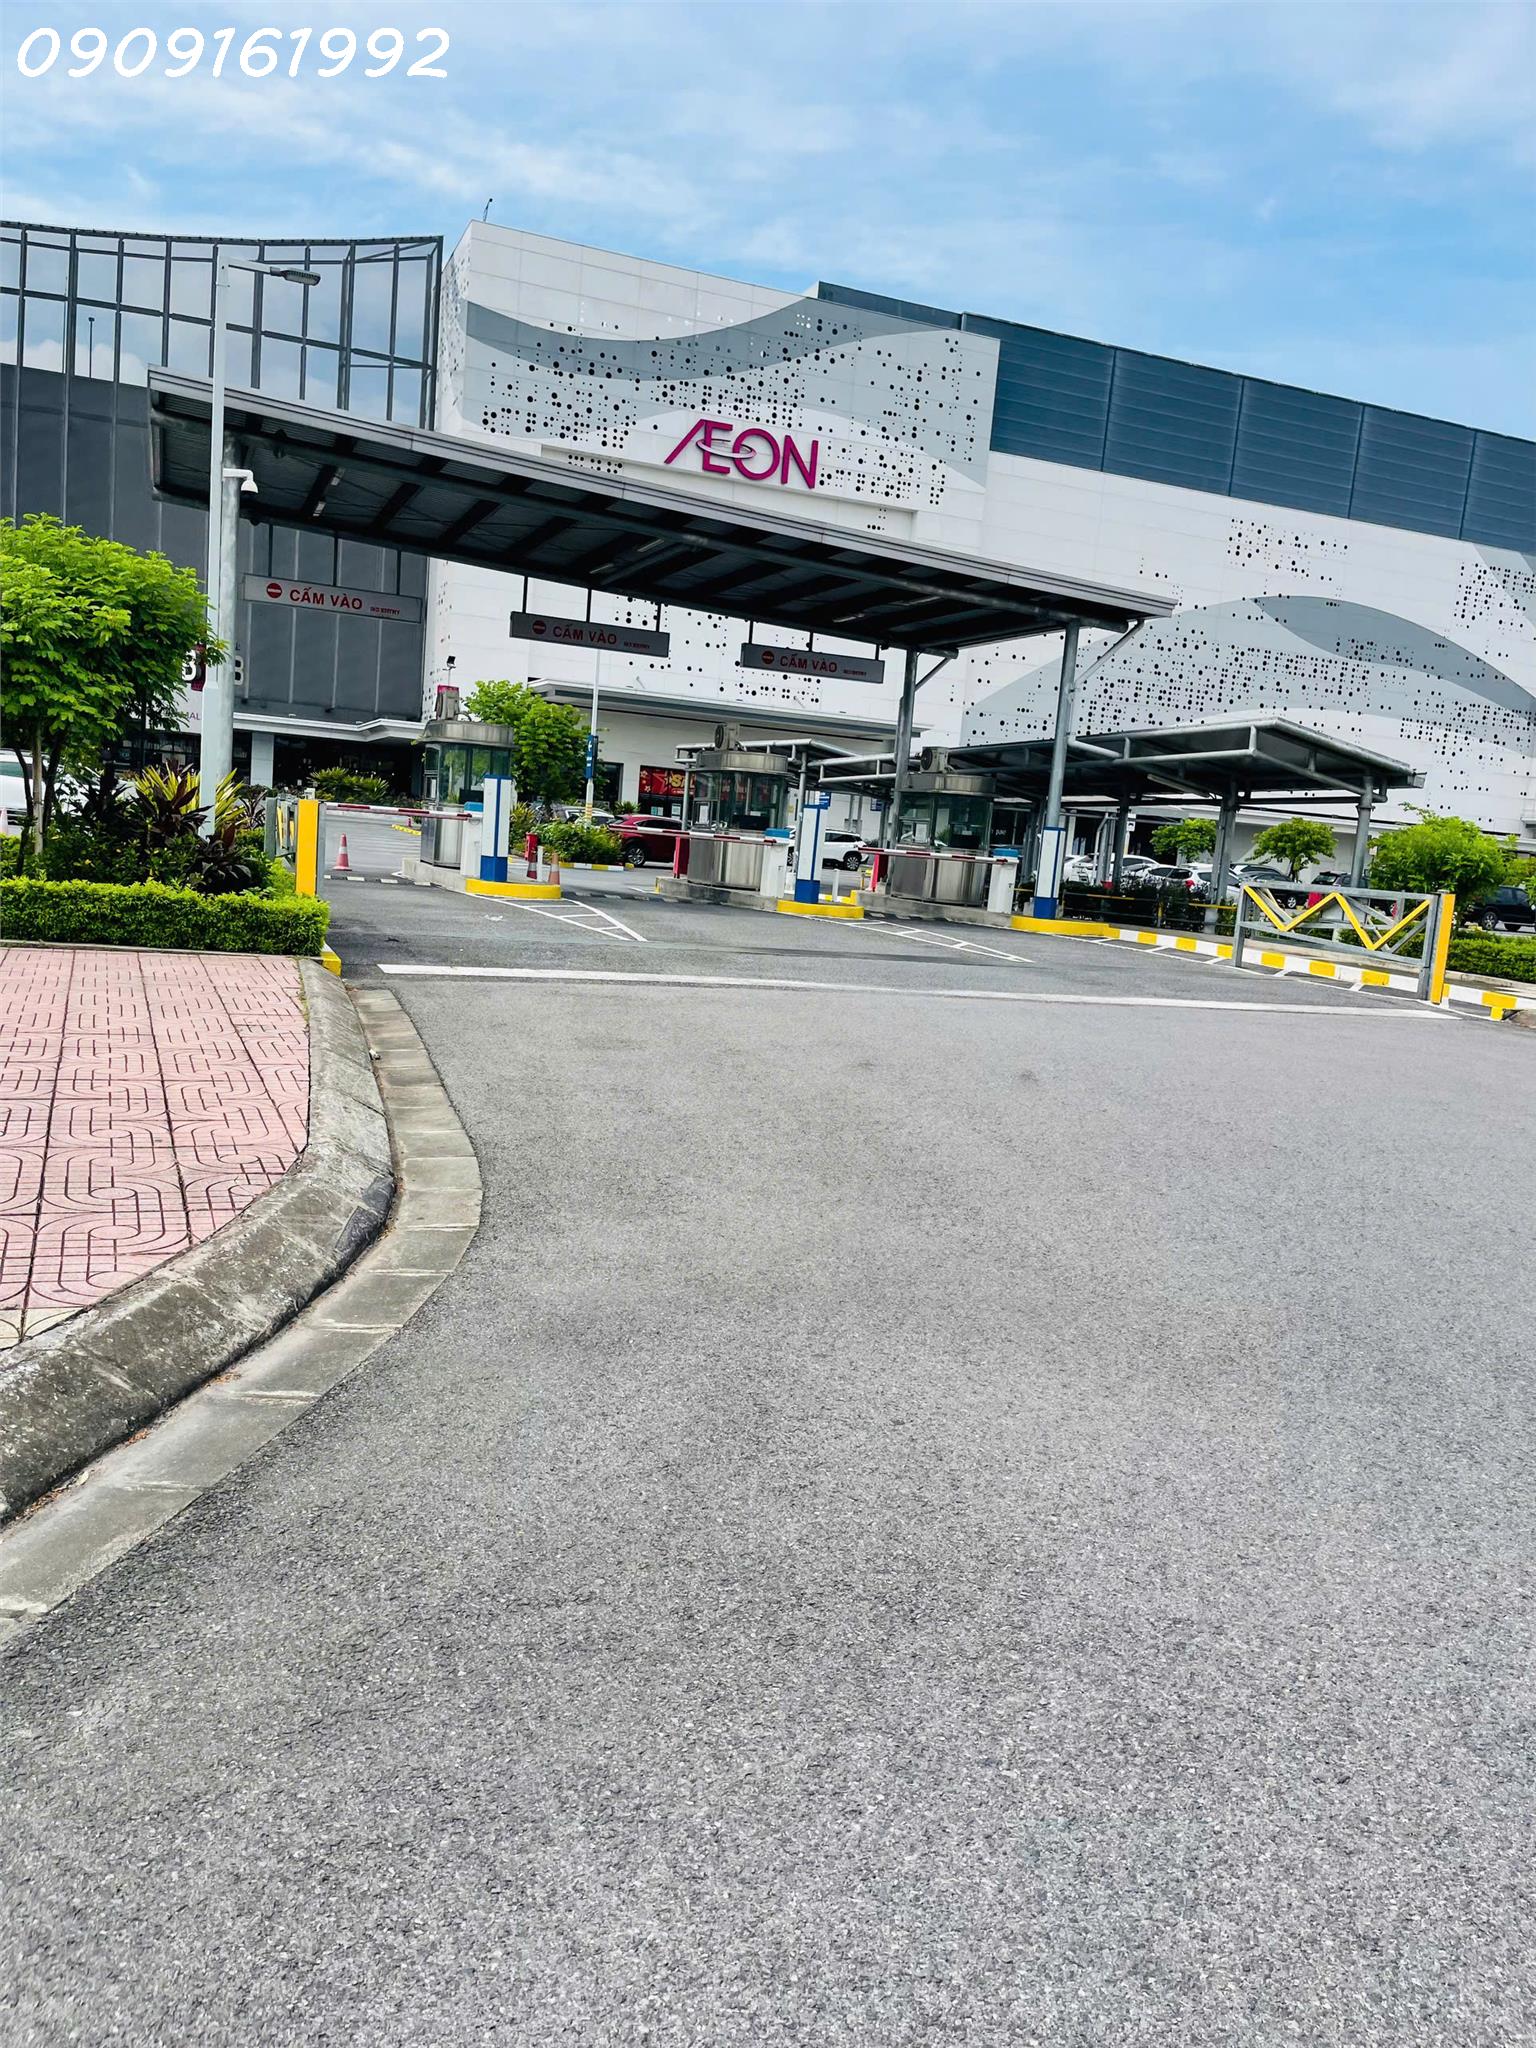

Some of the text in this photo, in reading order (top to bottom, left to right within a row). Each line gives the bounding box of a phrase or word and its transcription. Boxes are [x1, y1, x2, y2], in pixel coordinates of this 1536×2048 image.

[289, 586, 325, 606] CẤM
[329, 592, 363, 610] VÀO
[552, 622, 584, 641] CẤM
[588, 630, 618, 645] VÀO
[780, 653, 808, 670] CẤM
[811, 658, 838, 673] VÀO
